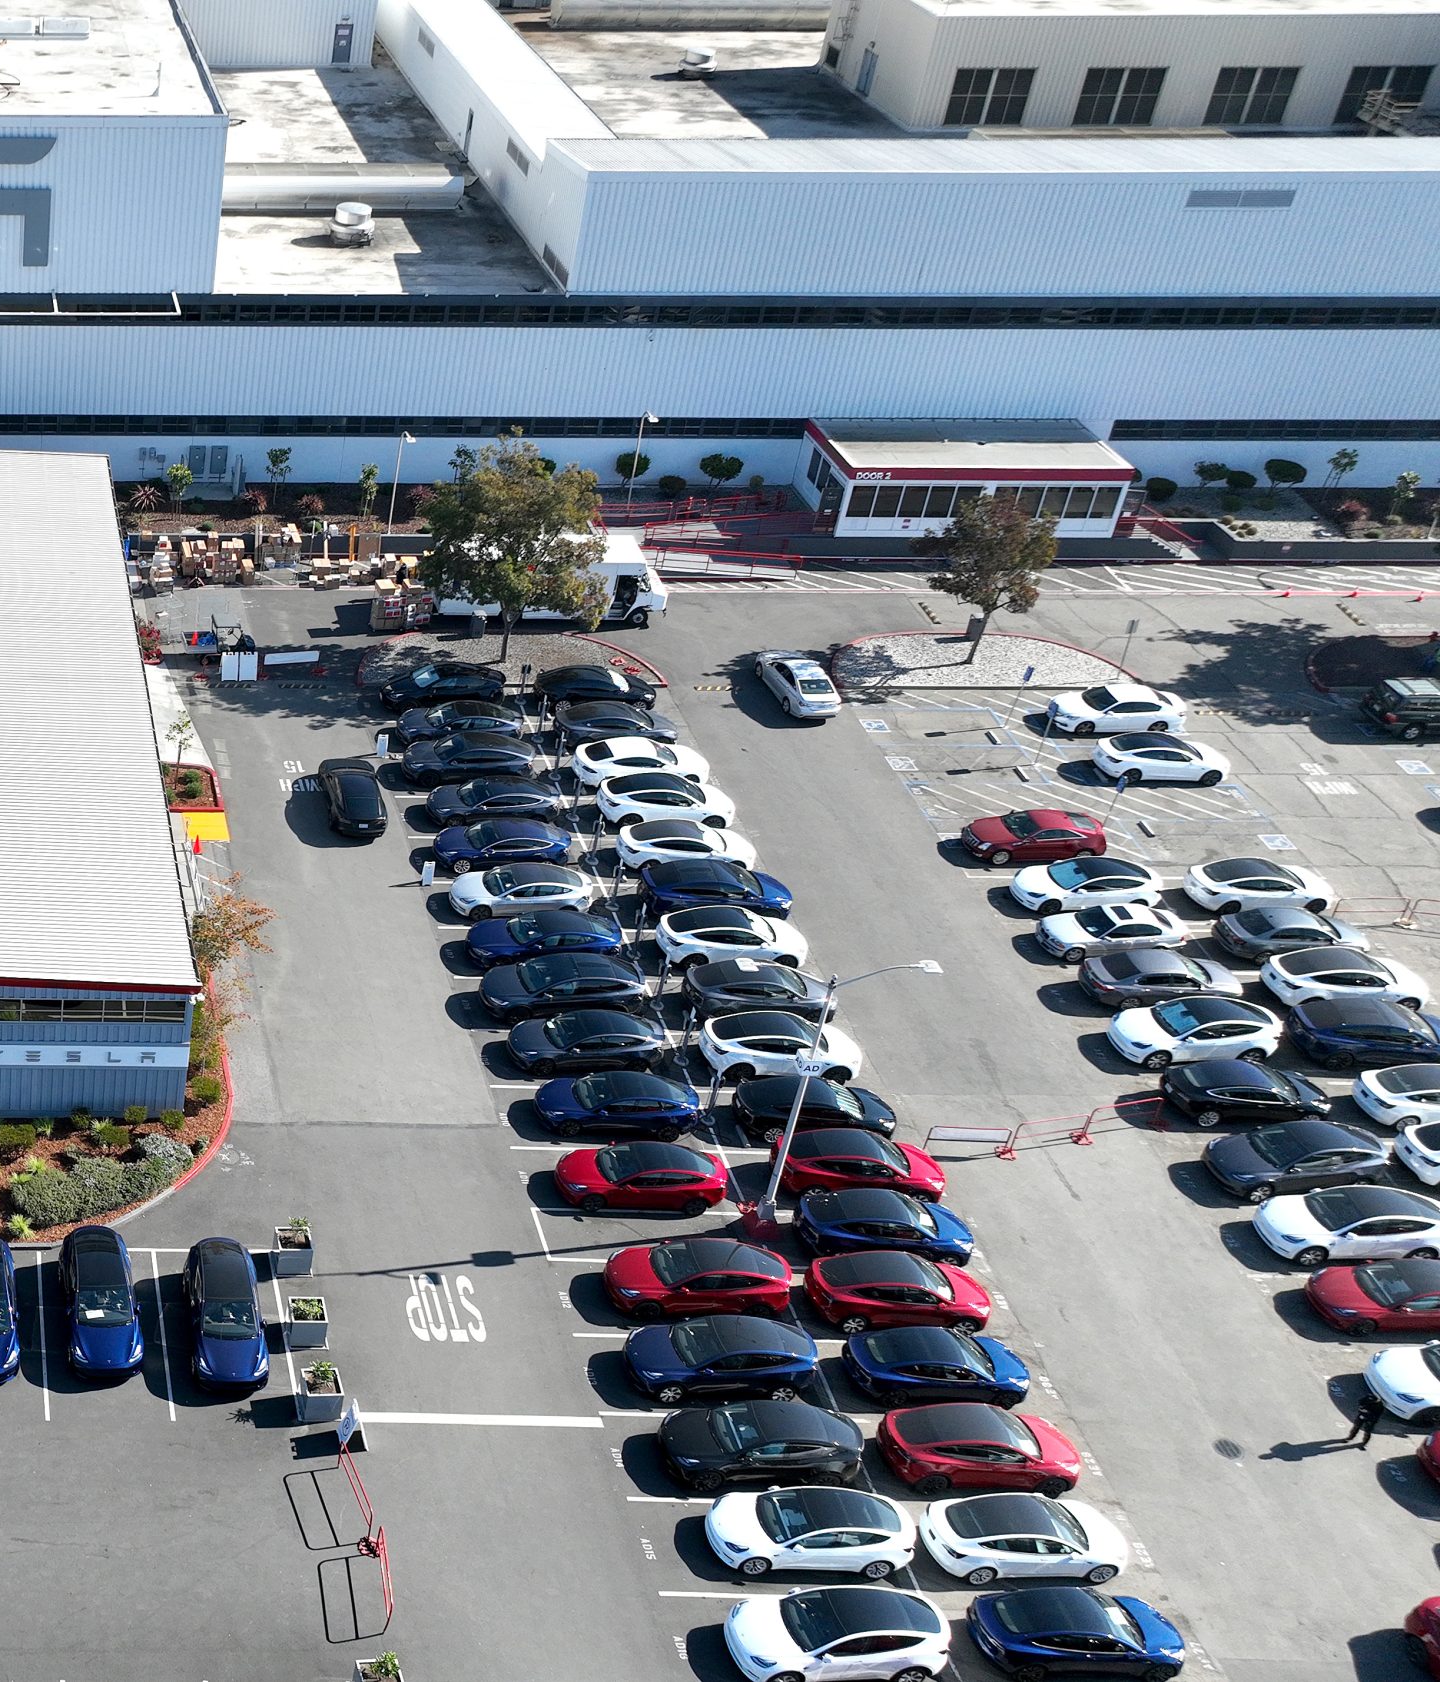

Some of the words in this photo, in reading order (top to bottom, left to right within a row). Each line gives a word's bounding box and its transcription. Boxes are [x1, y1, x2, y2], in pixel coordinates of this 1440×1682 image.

[855, 471, 884, 480] DOOR
[885, 471, 892, 480] 2
[283, 760, 306, 773] 15
[1299, 762, 1330, 776] 15
[1304, 781, 1360, 795] MPH
[499, 1112, 510, 1127] AD10
[518, 1170, 529, 1185] AD11
[558, 1290, 571, 1309] AD12
[405, 1274, 487, 1343] STOP
[583, 1367, 597, 1386] AD13
[610, 1447, 624, 1467] AD14
[640, 1538, 656, 1561] AD15
[673, 1635, 688, 1661] AD16
